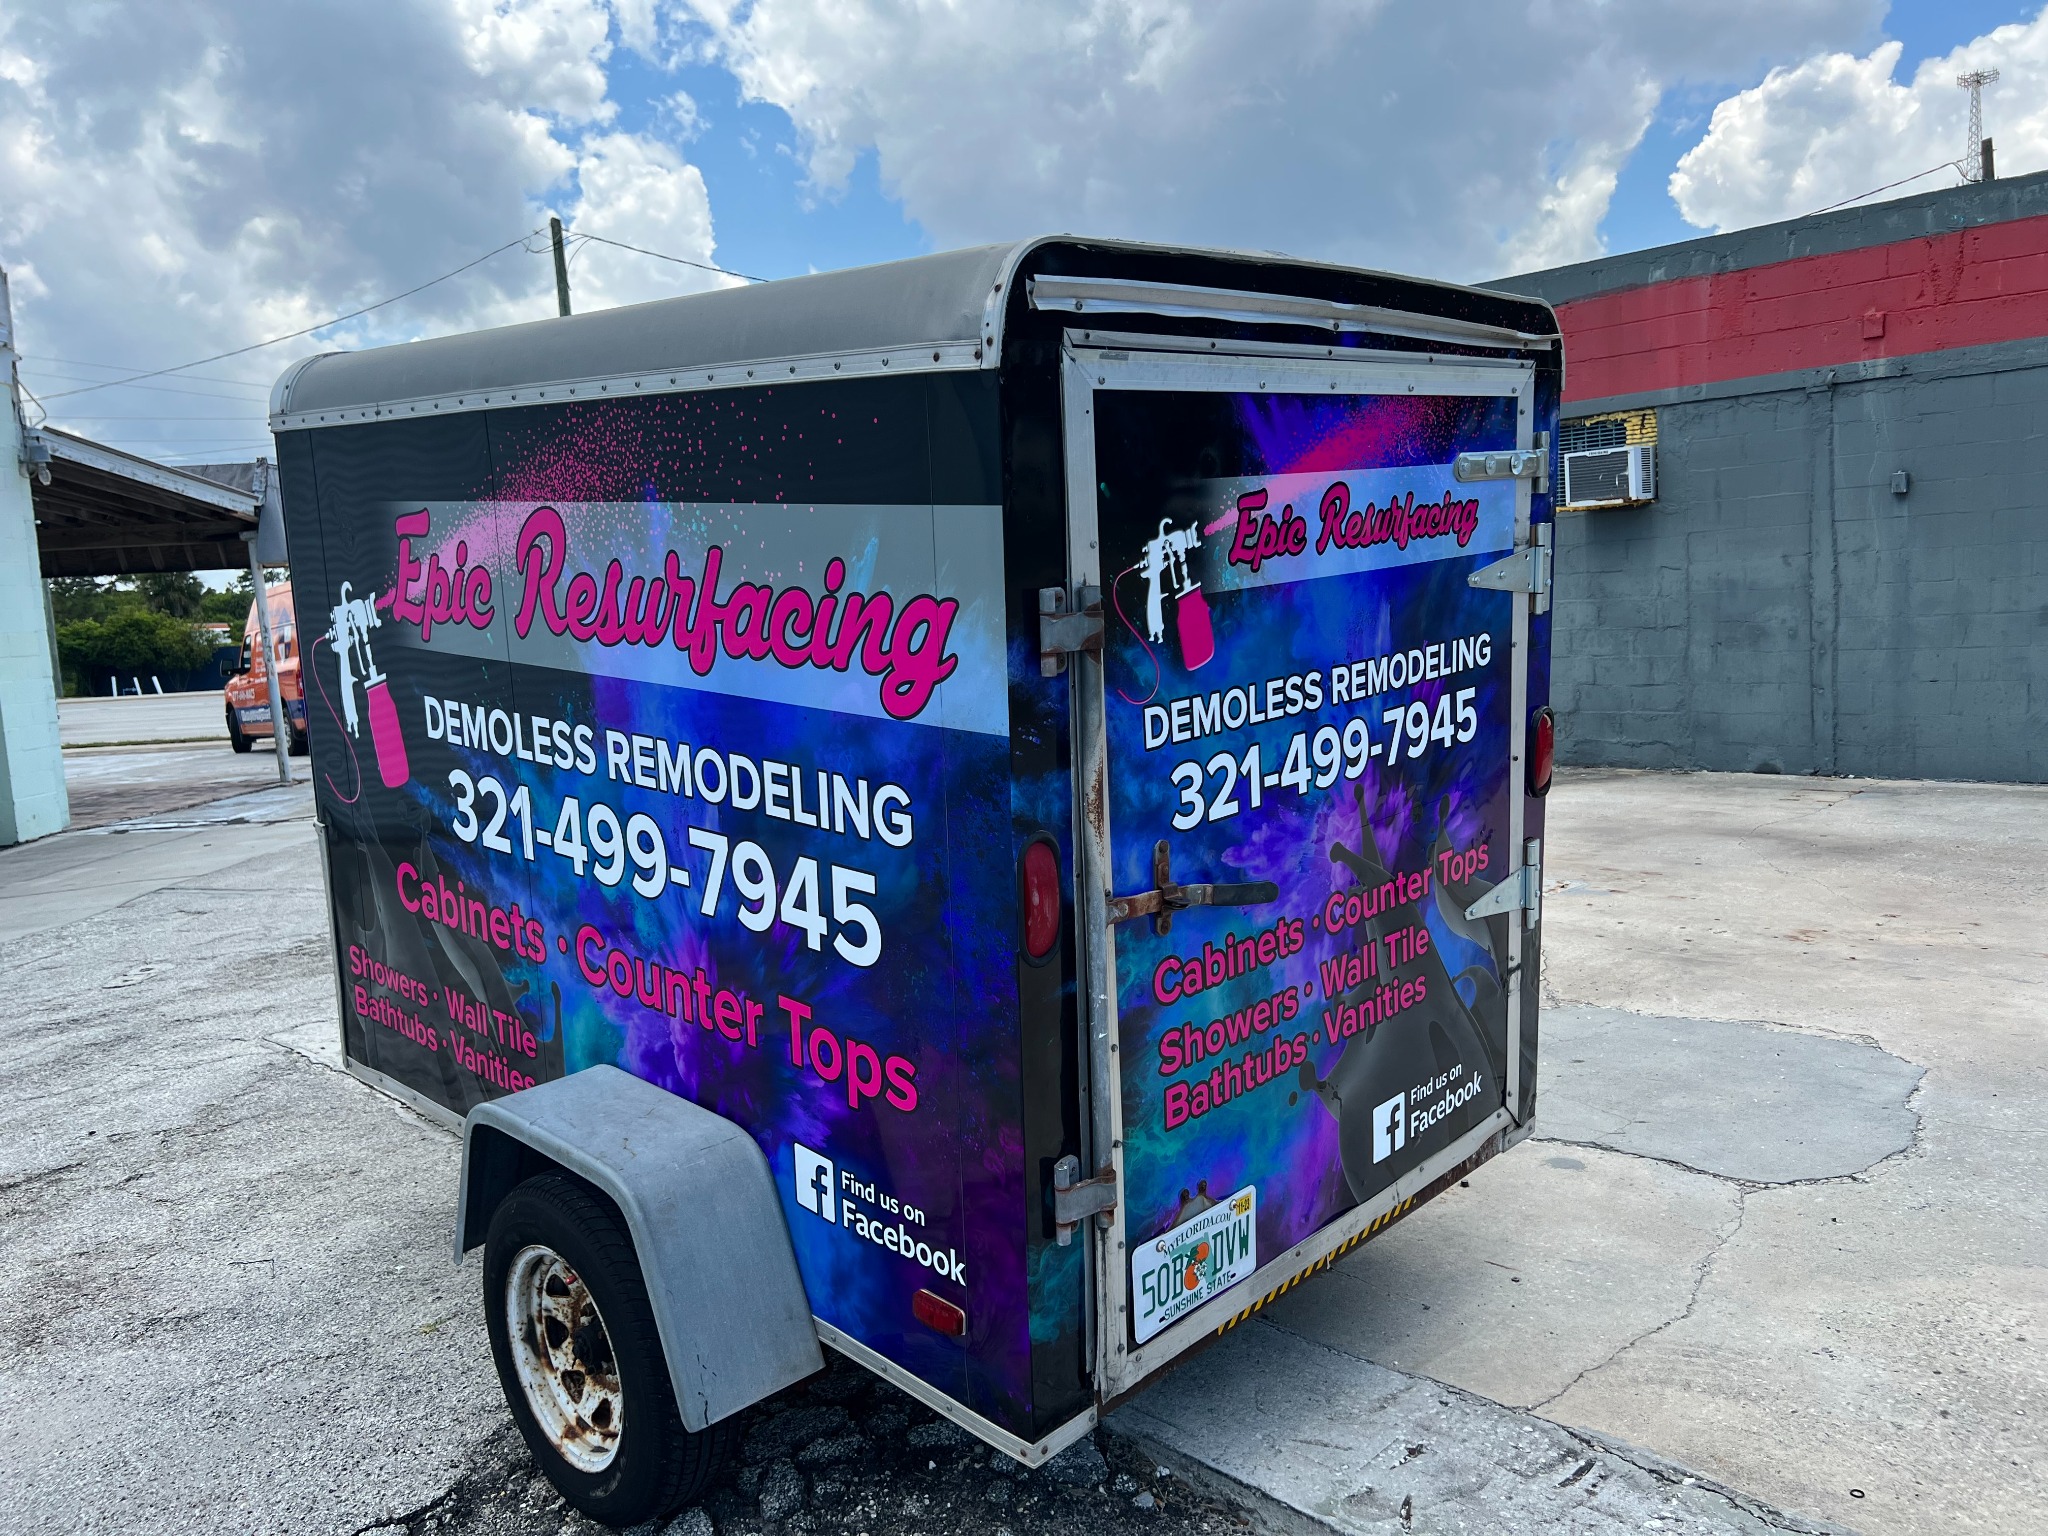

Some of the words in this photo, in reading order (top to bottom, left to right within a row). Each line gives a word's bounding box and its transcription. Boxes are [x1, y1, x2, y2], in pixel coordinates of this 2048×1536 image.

[1229, 488, 1307, 572] Epic
[1315, 481, 1478, 555] Resurfacing
[392, 508, 495, 642] Epic
[515, 506, 958, 719] Resurfacing
[1144, 671, 1323, 749] DEMOLESS
[1332, 633, 1491, 705] REMODELING
[424, 696, 597, 775] DEMOLESS
[607, 731, 912, 848] REMODELING
[1171, 687, 1478, 831] 321-499-7945
[447, 769, 882, 967] 321-499-7945
[1153, 918, 1303, 1005] Cabinets
[1324, 866, 1432, 934] Counter
[1439, 844, 1488, 886] Tops
[350, 944, 428, 1007] Showers
[444, 986, 488, 1037] Wall
[493, 1009, 537, 1058] Tile
[354, 984, 438, 1051] Bathtubs
[396, 862, 547, 963] Cabinets
[575, 924, 764, 1047] Counter
[779, 995, 918, 1112] Tops
[1159, 986, 1298, 1077] Showers
[1320, 940, 1377, 999] Wall
[1384, 926, 1430, 971] Tile
[1164, 1033, 1309, 1131] Bathtubs
[1323, 974, 1427, 1047] Vanities
[1411, 1077, 1433, 1106] Find
[1436, 1073, 1448, 1090] us
[1449, 1063, 1462, 1081] on
[1411, 1070, 1482, 1138] Facebook
[841, 1170, 875, 1203] Find
[880, 1193, 899, 1214] us
[904, 1204, 925, 1226] on
[842, 1199, 967, 1286] Facebook
[1211, 1214, 1250, 1277] DVW
[1164, 1289, 1204, 1321] SUNSHINE
[1206, 1270, 1232, 1295] STATE
